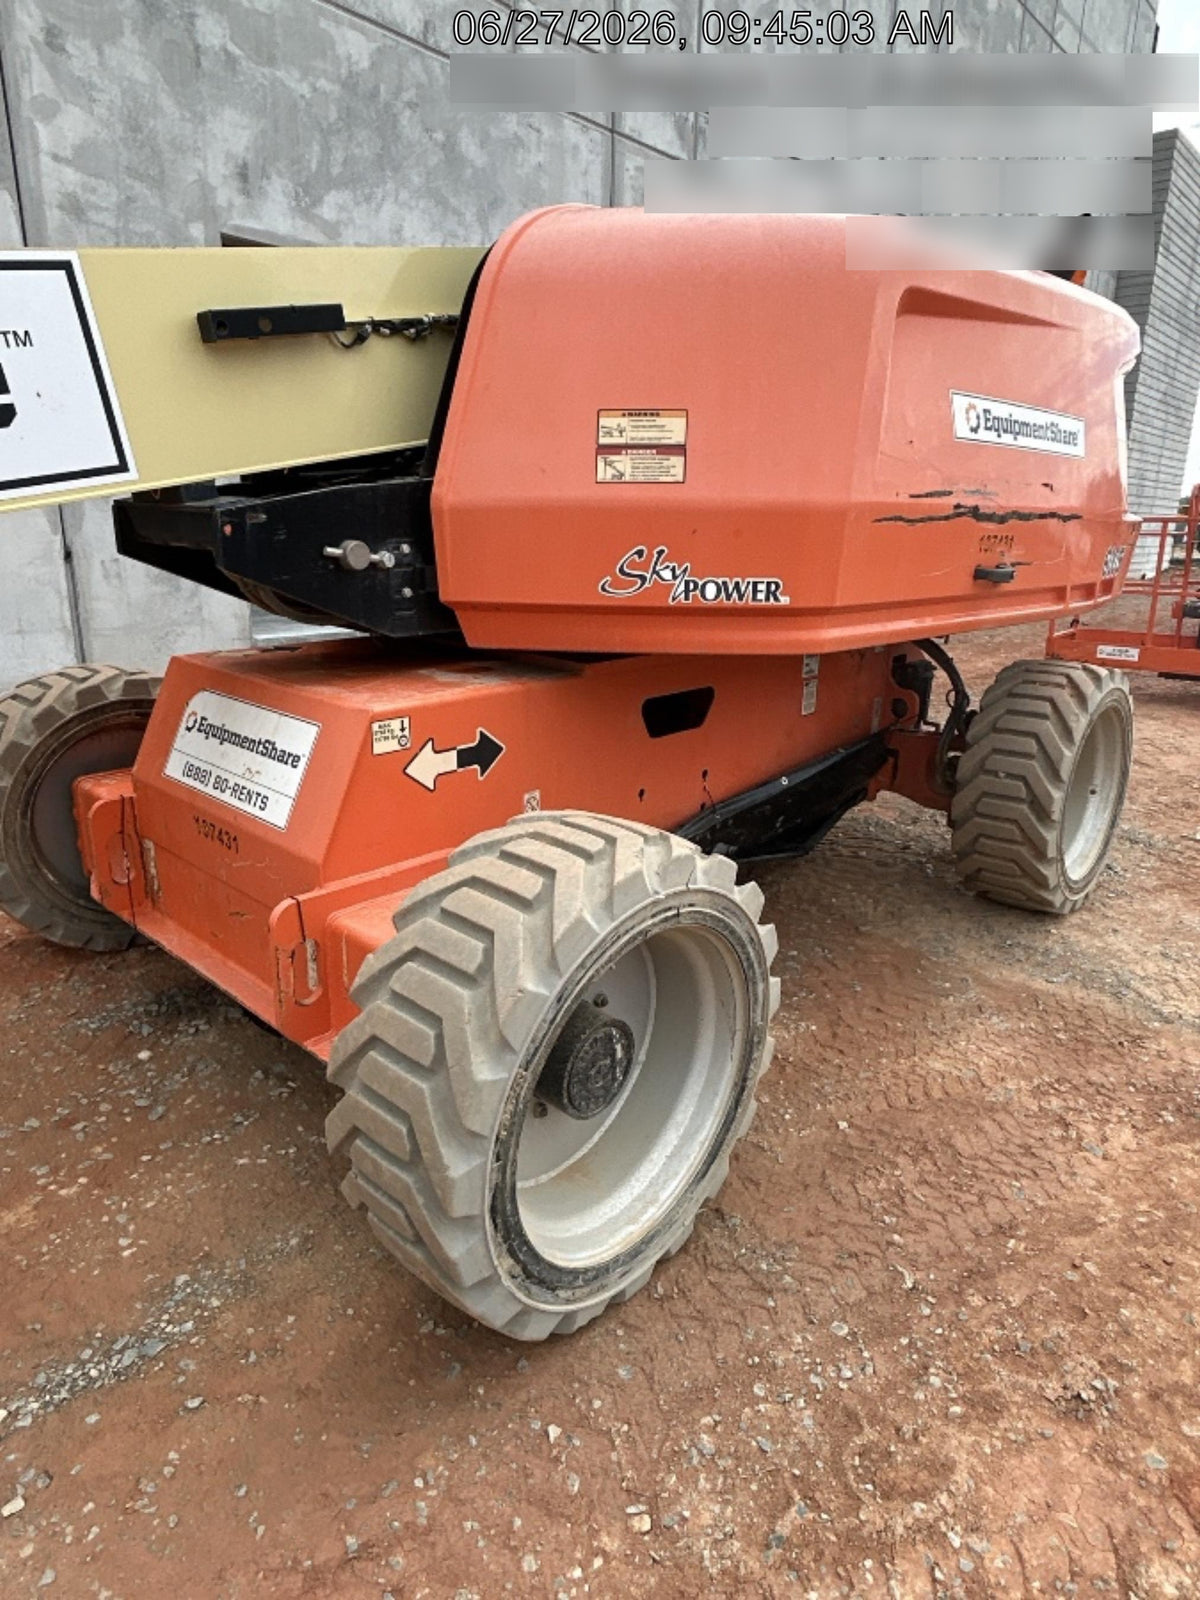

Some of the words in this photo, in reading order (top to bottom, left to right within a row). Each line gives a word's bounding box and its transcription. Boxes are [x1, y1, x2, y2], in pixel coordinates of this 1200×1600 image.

[0, 330, 34, 348] TM
[982, 408, 1079, 447] EquipmentShare
[600, 547, 690, 604] Sky
[683, 578, 784, 604] POWER
[196, 716, 301, 769] EquipmentShare
[182, 760, 213, 787] (888)
[212, 774, 270, 812] 80-RENTS
